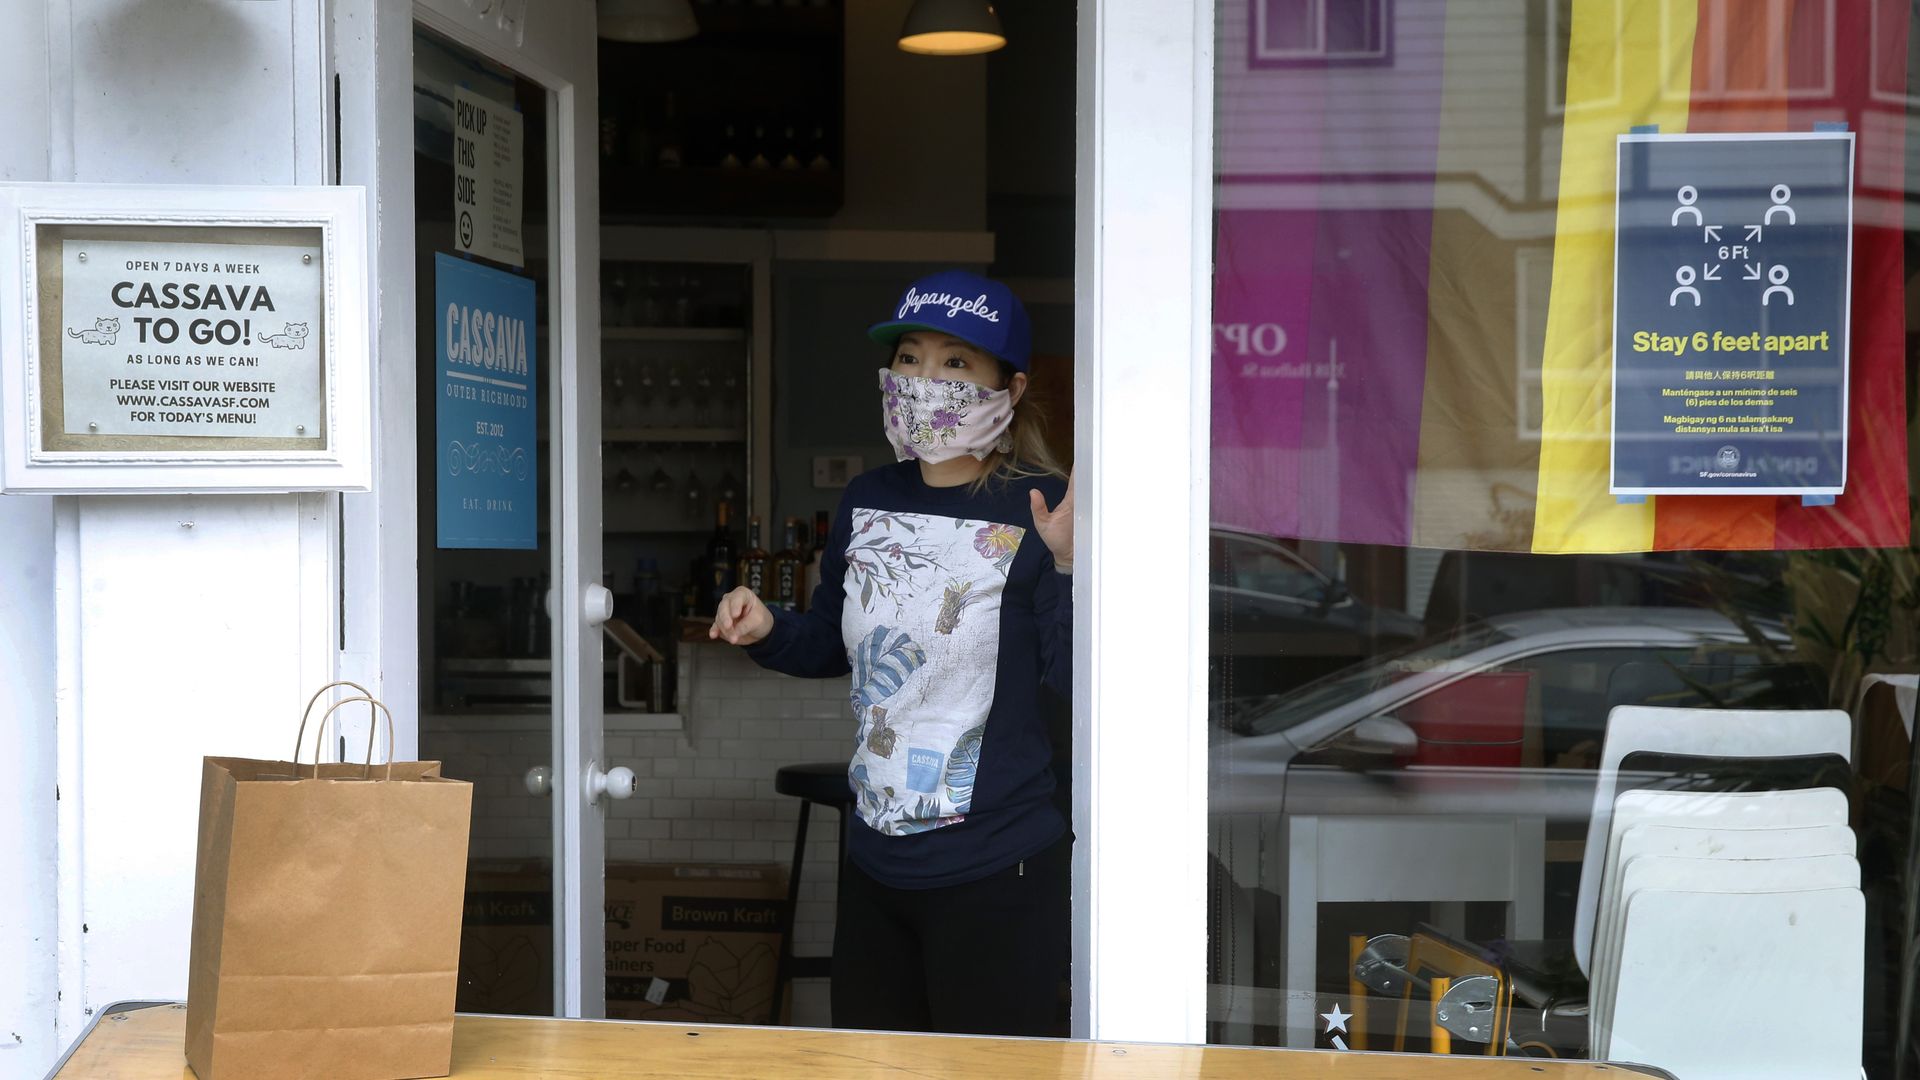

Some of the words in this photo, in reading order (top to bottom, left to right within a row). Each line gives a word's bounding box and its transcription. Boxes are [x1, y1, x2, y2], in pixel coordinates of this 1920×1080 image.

[457, 99, 475, 132] PICK
[476, 108, 487, 136] UP
[457, 137, 475, 169] THIS
[457, 174, 476, 206] SIDE
[1718, 246, 1729, 260] 6
[1732, 246, 1749, 260] Ft
[126, 261, 159, 272] OPEN
[164, 262, 171, 272] 7
[176, 262, 209, 273] DAYS
[213, 263, 222, 273] A
[225, 264, 260, 275] WEEK
[111, 281, 275, 312] CASSAVA
[899, 287, 999, 322] Japangeles
[133, 317, 179, 344] TO
[189, 319, 251, 346] GO!
[446, 302, 528, 376] CASSAVA
[1633, 331, 1688, 355] Stay
[1692, 332, 1708, 352] 6
[1712, 331, 1760, 351] feet
[1764, 331, 1829, 355] apart
[127, 355, 143, 365] AS
[148, 355, 181, 366] LONG
[186, 356, 201, 366] AS
[206, 356, 225, 367] WE
[230, 356, 259, 367] CAN!
[110, 379, 155, 391] PLEASE
[158, 380, 190, 392] VISIT
[193, 381, 220, 392] OUR
[223, 382, 276, 393] WEBSITE
[1767, 388, 1779, 396] de
[1779, 388, 1798, 396] seis
[117, 395, 270, 409] WWW.CASSAVASF.COM
[446, 383, 477, 401] OUTER
[481, 386, 528, 409] RICHMOND
[1685, 398, 1698, 407] (6)
[1699, 398, 1717, 407] pies
[1718, 398, 1730, 406] de
[1730, 398, 1744, 406] los
[131, 411, 155, 423] FOR
[159, 412, 213, 424] TODAY'S
[217, 413, 256, 424] MENU!
[1663, 415, 1705, 425] Magbigay
[1706, 417, 1717, 425] ng
[1718, 415, 1725, 423] 6
[1737, 415, 1794, 425] talampakang
[476, 421, 489, 435] EST.
[490, 423, 504, 438] 2012
[1675, 425, 1716, 434] distansya
[1717, 425, 1739, 433] mula
[1739, 425, 1750, 433] sa
[1770, 425, 1783, 433] isa
[486, 499, 513, 512] DRINK
[672, 905, 728, 922] Brown
[733, 907, 777, 924] Kraft
[644, 937, 686, 954] Food
